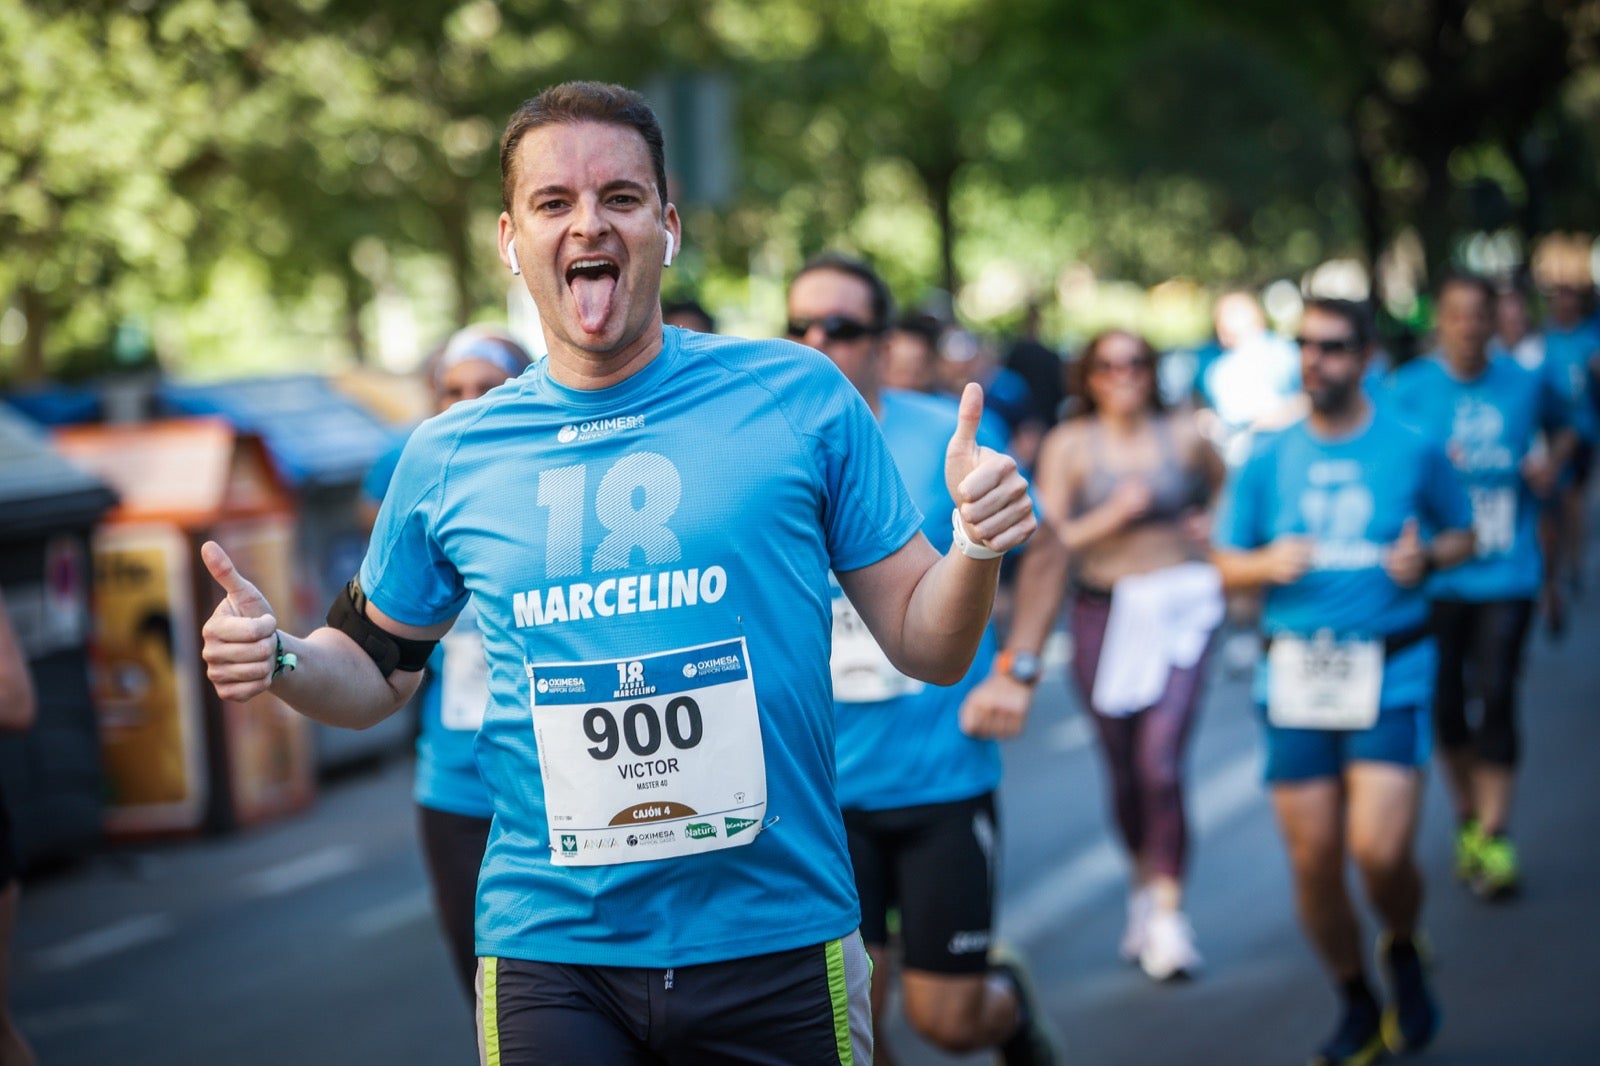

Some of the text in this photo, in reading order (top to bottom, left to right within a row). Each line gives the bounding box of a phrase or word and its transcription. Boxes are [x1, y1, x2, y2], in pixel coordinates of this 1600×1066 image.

[537, 451, 682, 579] 18
[513, 565, 727, 628] MARCELINO
[697, 654, 739, 670] OXIMESA
[616, 661, 645, 684] 18
[549, 677, 584, 686] OXIMESA
[613, 685, 656, 698] MARCELINO
[583, 696, 703, 761] 900
[617, 758, 680, 779] VICTOR
[636, 779, 668, 790] MASTER 40
[632, 806, 671, 819] CAJÓN 4
[639, 830, 675, 841] OXIMESA
[685, 825, 718, 838] Natura
